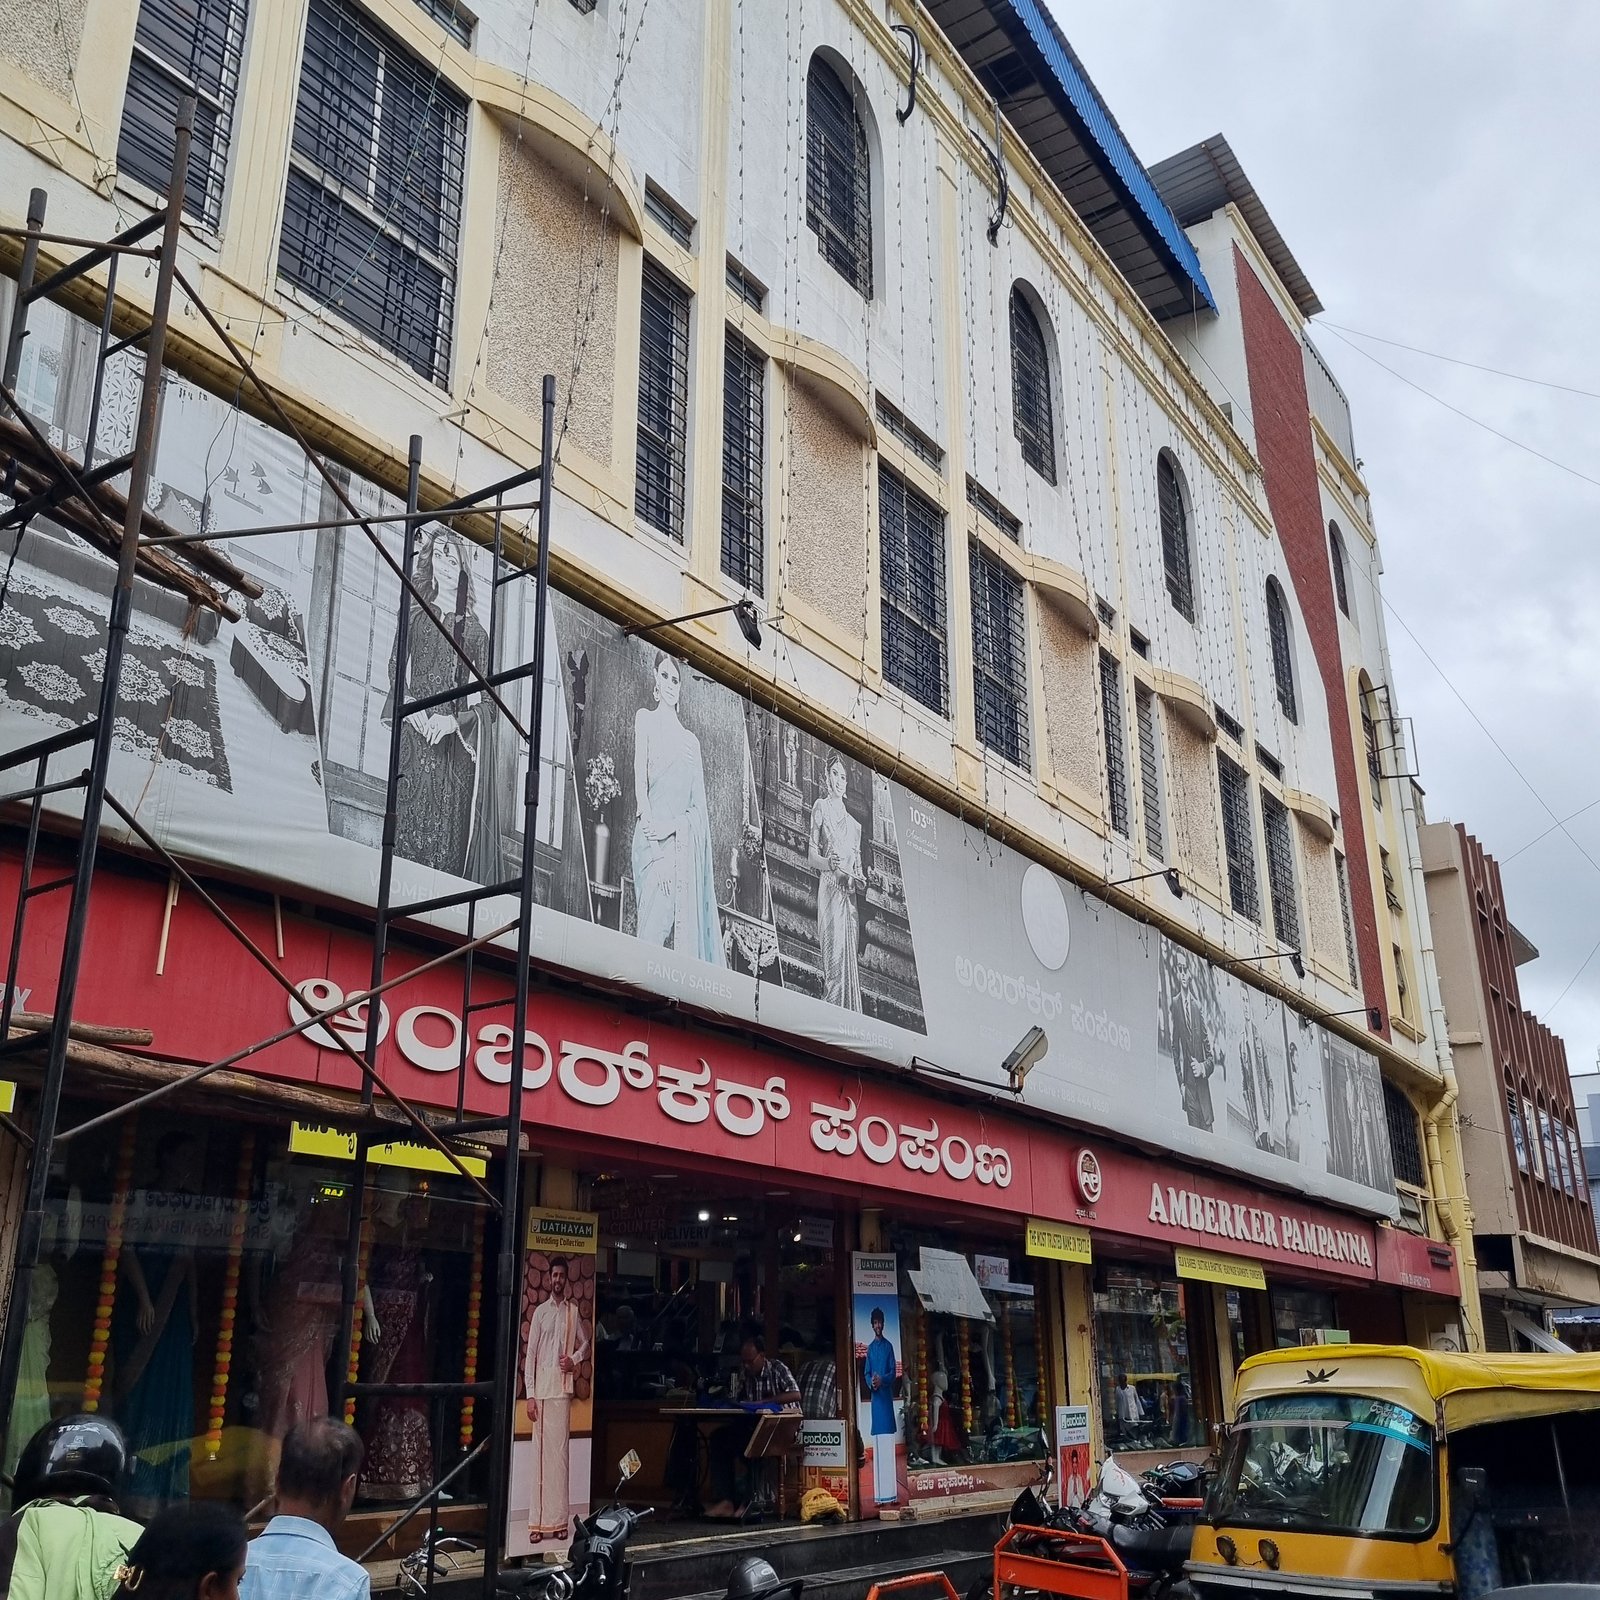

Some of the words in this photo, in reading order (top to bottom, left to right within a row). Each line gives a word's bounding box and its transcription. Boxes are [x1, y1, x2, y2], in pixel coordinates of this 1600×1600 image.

[647, 959, 688, 986] FANCY
[688, 972, 733, 1001] SAREES
[838, 1022, 859, 1040] SILK
[859, 1028, 895, 1051] SAREES
[1148, 1182, 1279, 1248] AMBERKER
[1279, 1215, 1373, 1268] PAMPANNA
[536, 1235, 559, 1247] Wedding
[560, 1237, 585, 1248] Collection
[58, 1425, 81, 1433] TVS
